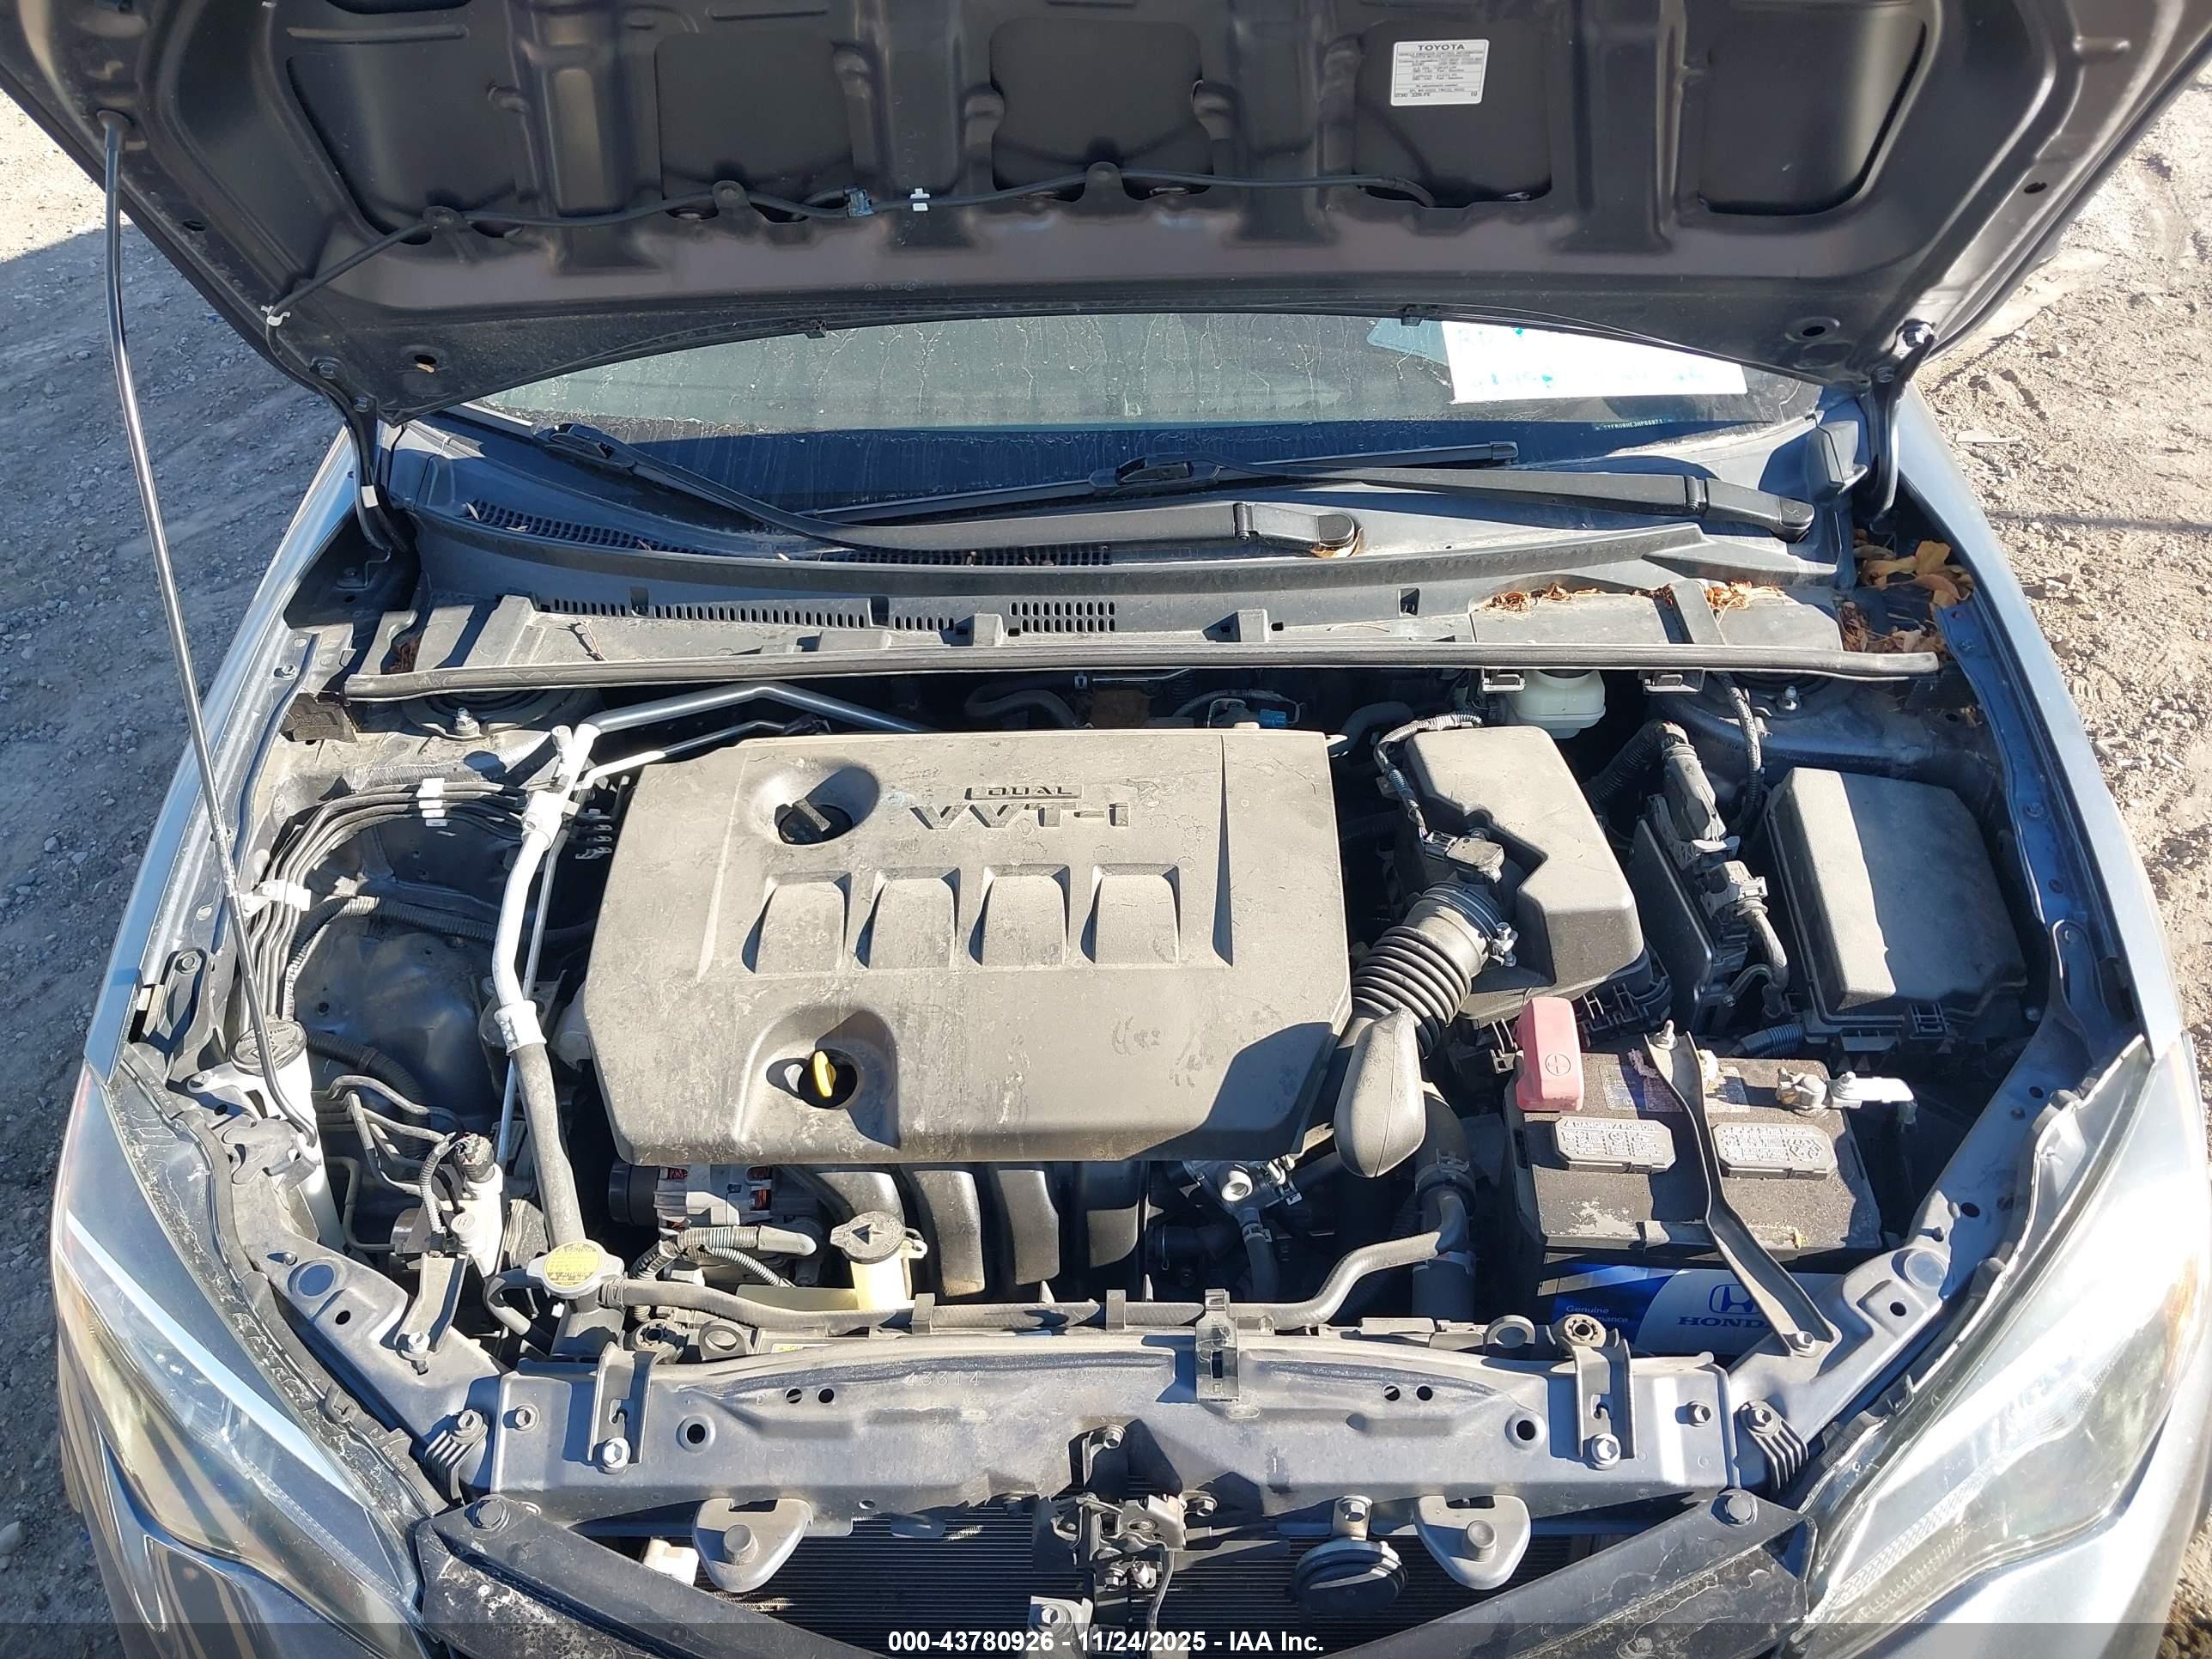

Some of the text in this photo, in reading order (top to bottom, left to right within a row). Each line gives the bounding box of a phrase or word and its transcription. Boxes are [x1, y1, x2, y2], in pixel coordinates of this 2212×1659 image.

[988, 786, 1073, 796] DUAL
[1565, 1304, 1610, 1314] Genuine
[1677, 1316, 1771, 1328] HOND
